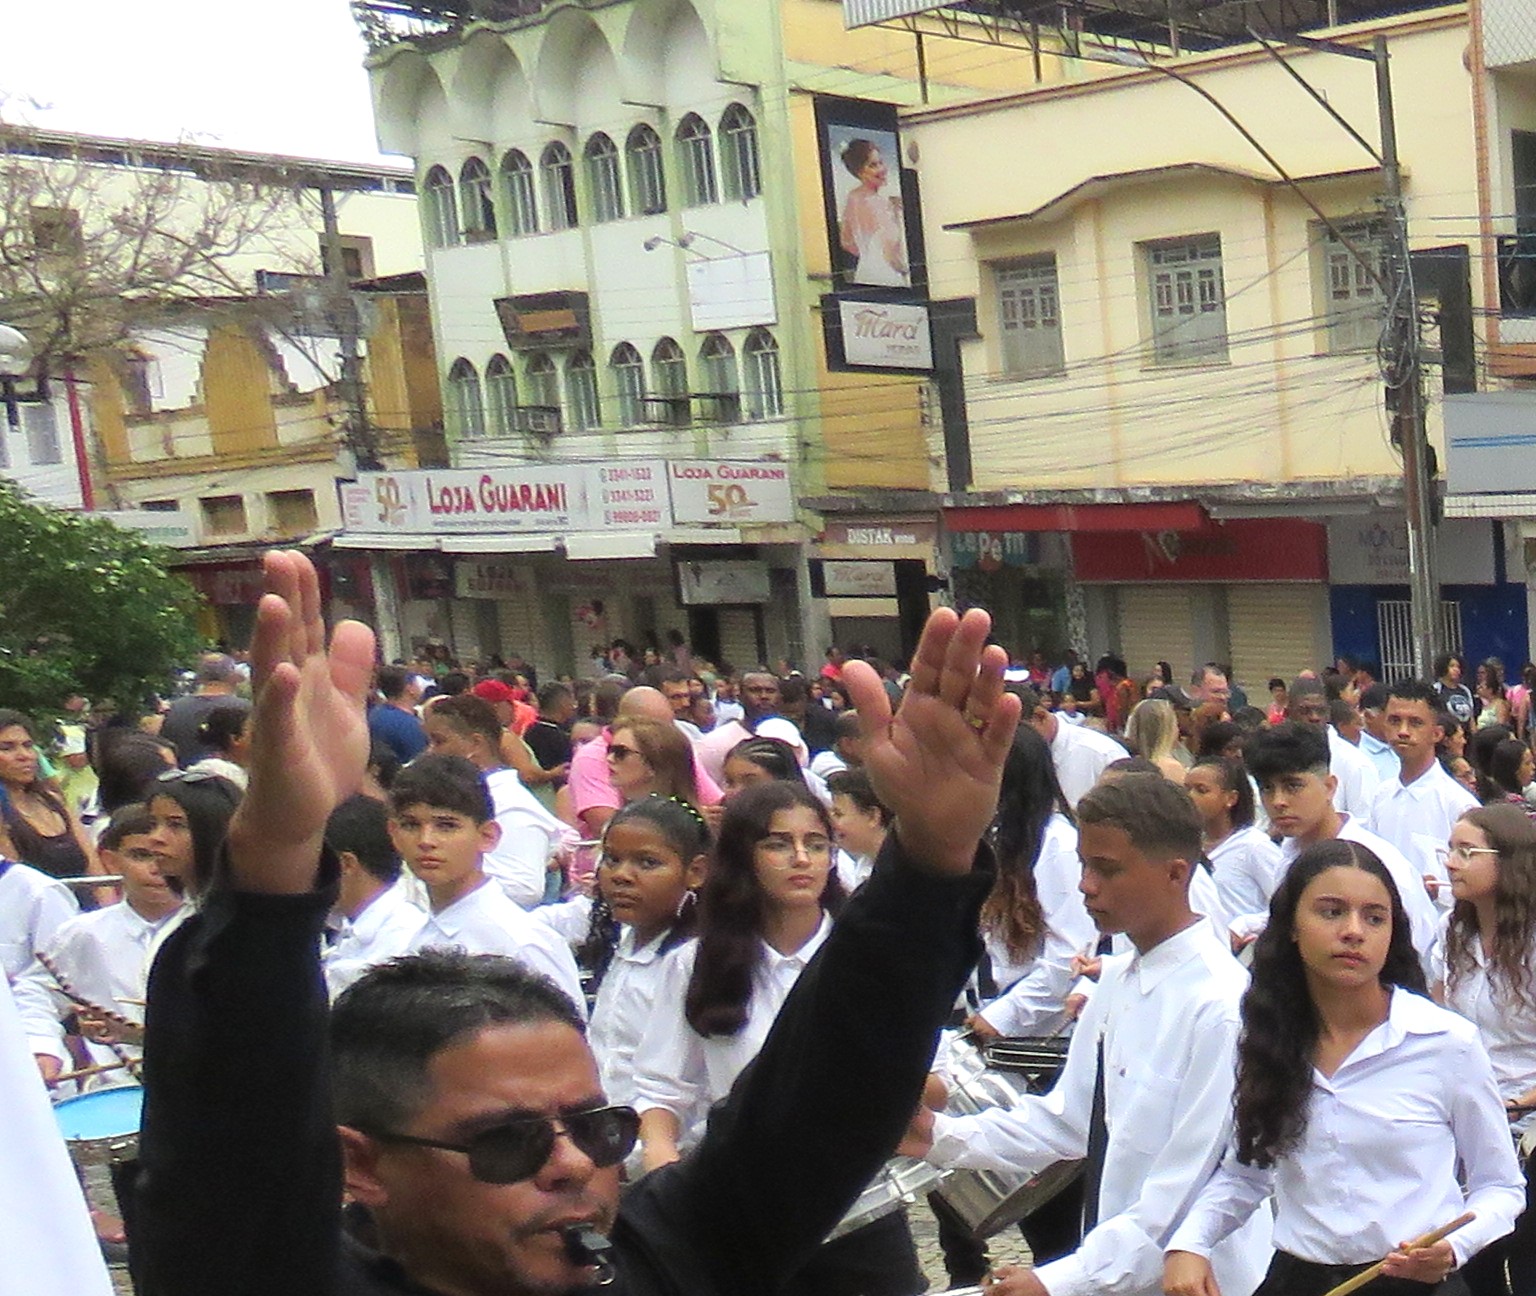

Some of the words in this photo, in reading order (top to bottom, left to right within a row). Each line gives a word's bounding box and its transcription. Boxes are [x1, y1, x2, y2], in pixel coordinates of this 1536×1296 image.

[673, 463, 713, 480] LOJA
[717, 464, 786, 481] GUARANI
[426, 476, 477, 514] LOJA
[479, 474, 569, 514] GUARANI
